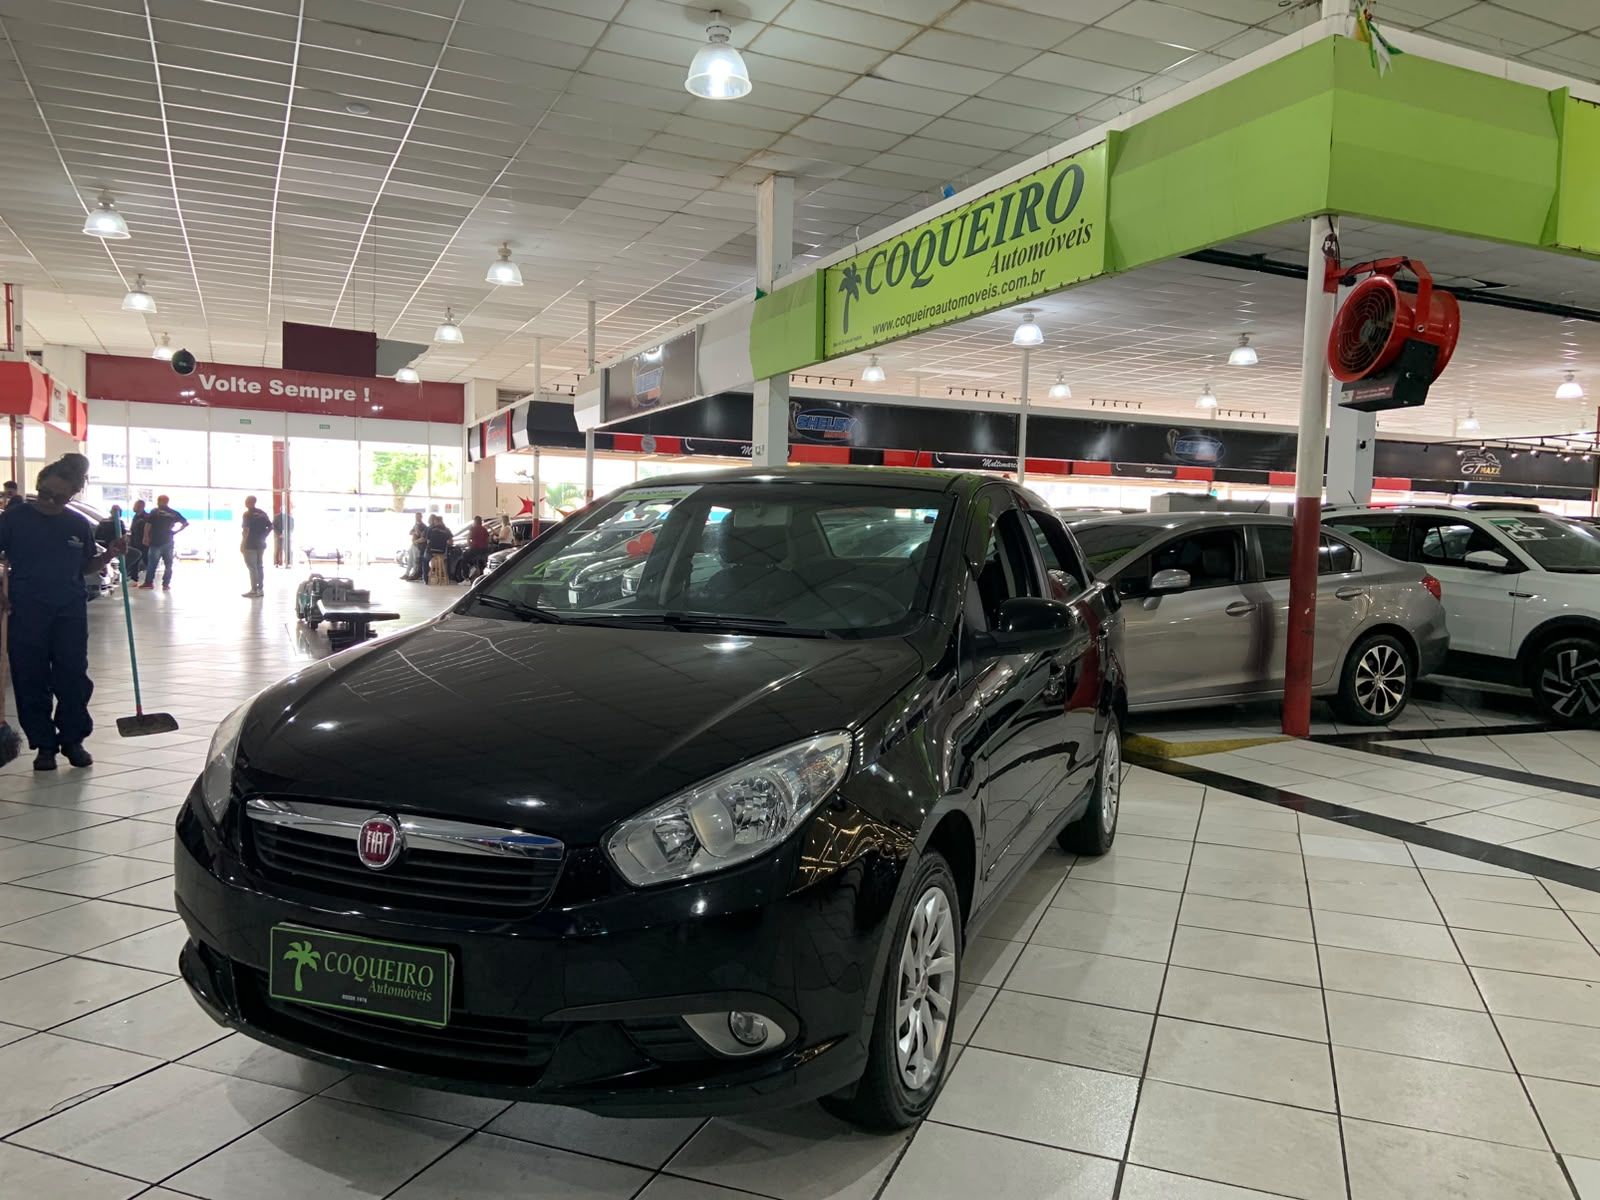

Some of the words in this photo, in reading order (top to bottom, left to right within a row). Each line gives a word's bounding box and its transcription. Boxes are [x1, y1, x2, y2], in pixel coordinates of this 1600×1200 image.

[865, 163, 1085, 295] COQUEIRO
[986, 218, 1093, 277] Automóveis
[1325, 241, 1337, 250] P4
[872, 267, 1046, 335] www.coqueiroautomoveis.com.br
[199, 374, 261, 394] Volte
[269, 379, 357, 402] Sempre
[363, 387, 370, 402] !
[796, 414, 857, 432] SHELBY
[1461, 463, 1486, 474] GT
[365, 830, 390, 855] FIAT
[324, 951, 434, 988] COQUEIRO
[368, 980, 432, 1002] Automóveis
